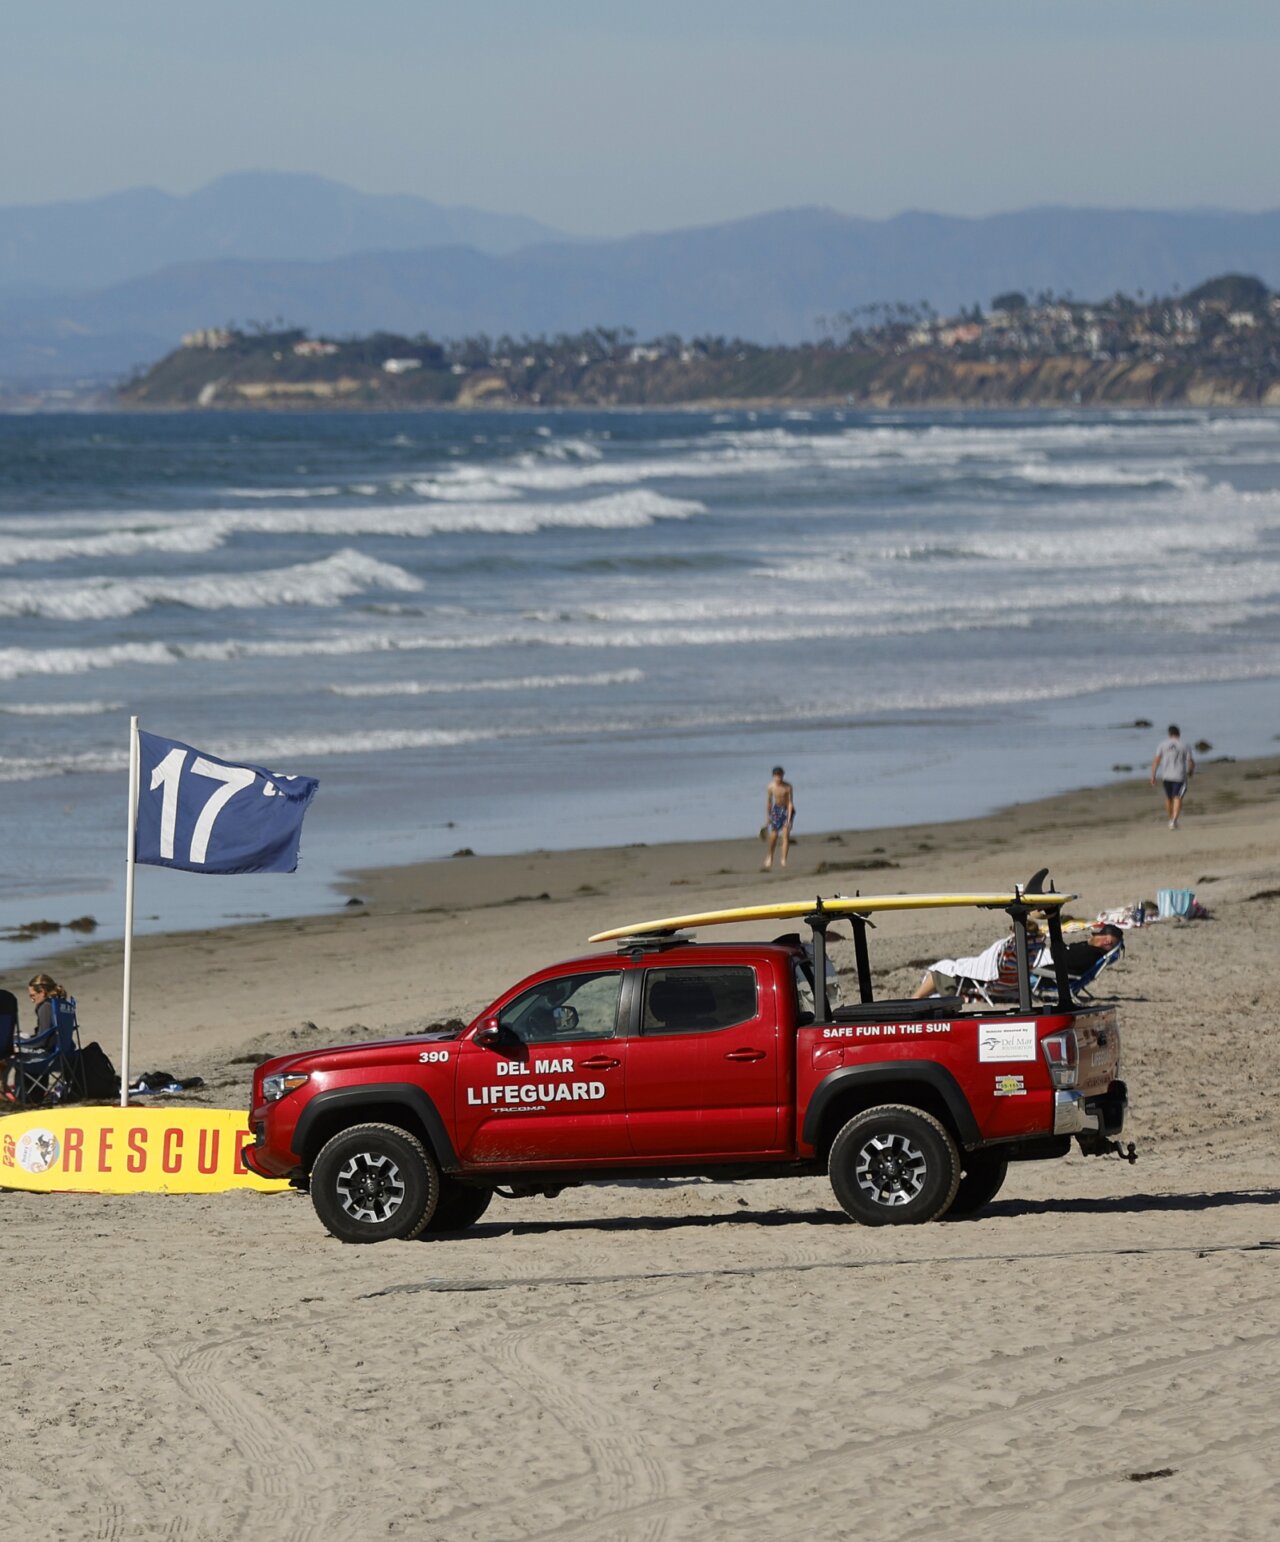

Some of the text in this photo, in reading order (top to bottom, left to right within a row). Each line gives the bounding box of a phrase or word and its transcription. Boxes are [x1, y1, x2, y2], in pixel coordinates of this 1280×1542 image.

[823, 1023, 951, 1037] SAFE FUN IN THE SUN
[1001, 1035, 1033, 1046] Del Mar
[419, 1051, 450, 1063] 390
[496, 1058, 574, 1076] DEL MAR
[467, 1081, 606, 1105] LIFEGUARD
[491, 1105, 546, 1113] TACOMA
[62, 1128, 250, 1174] RESCUE
